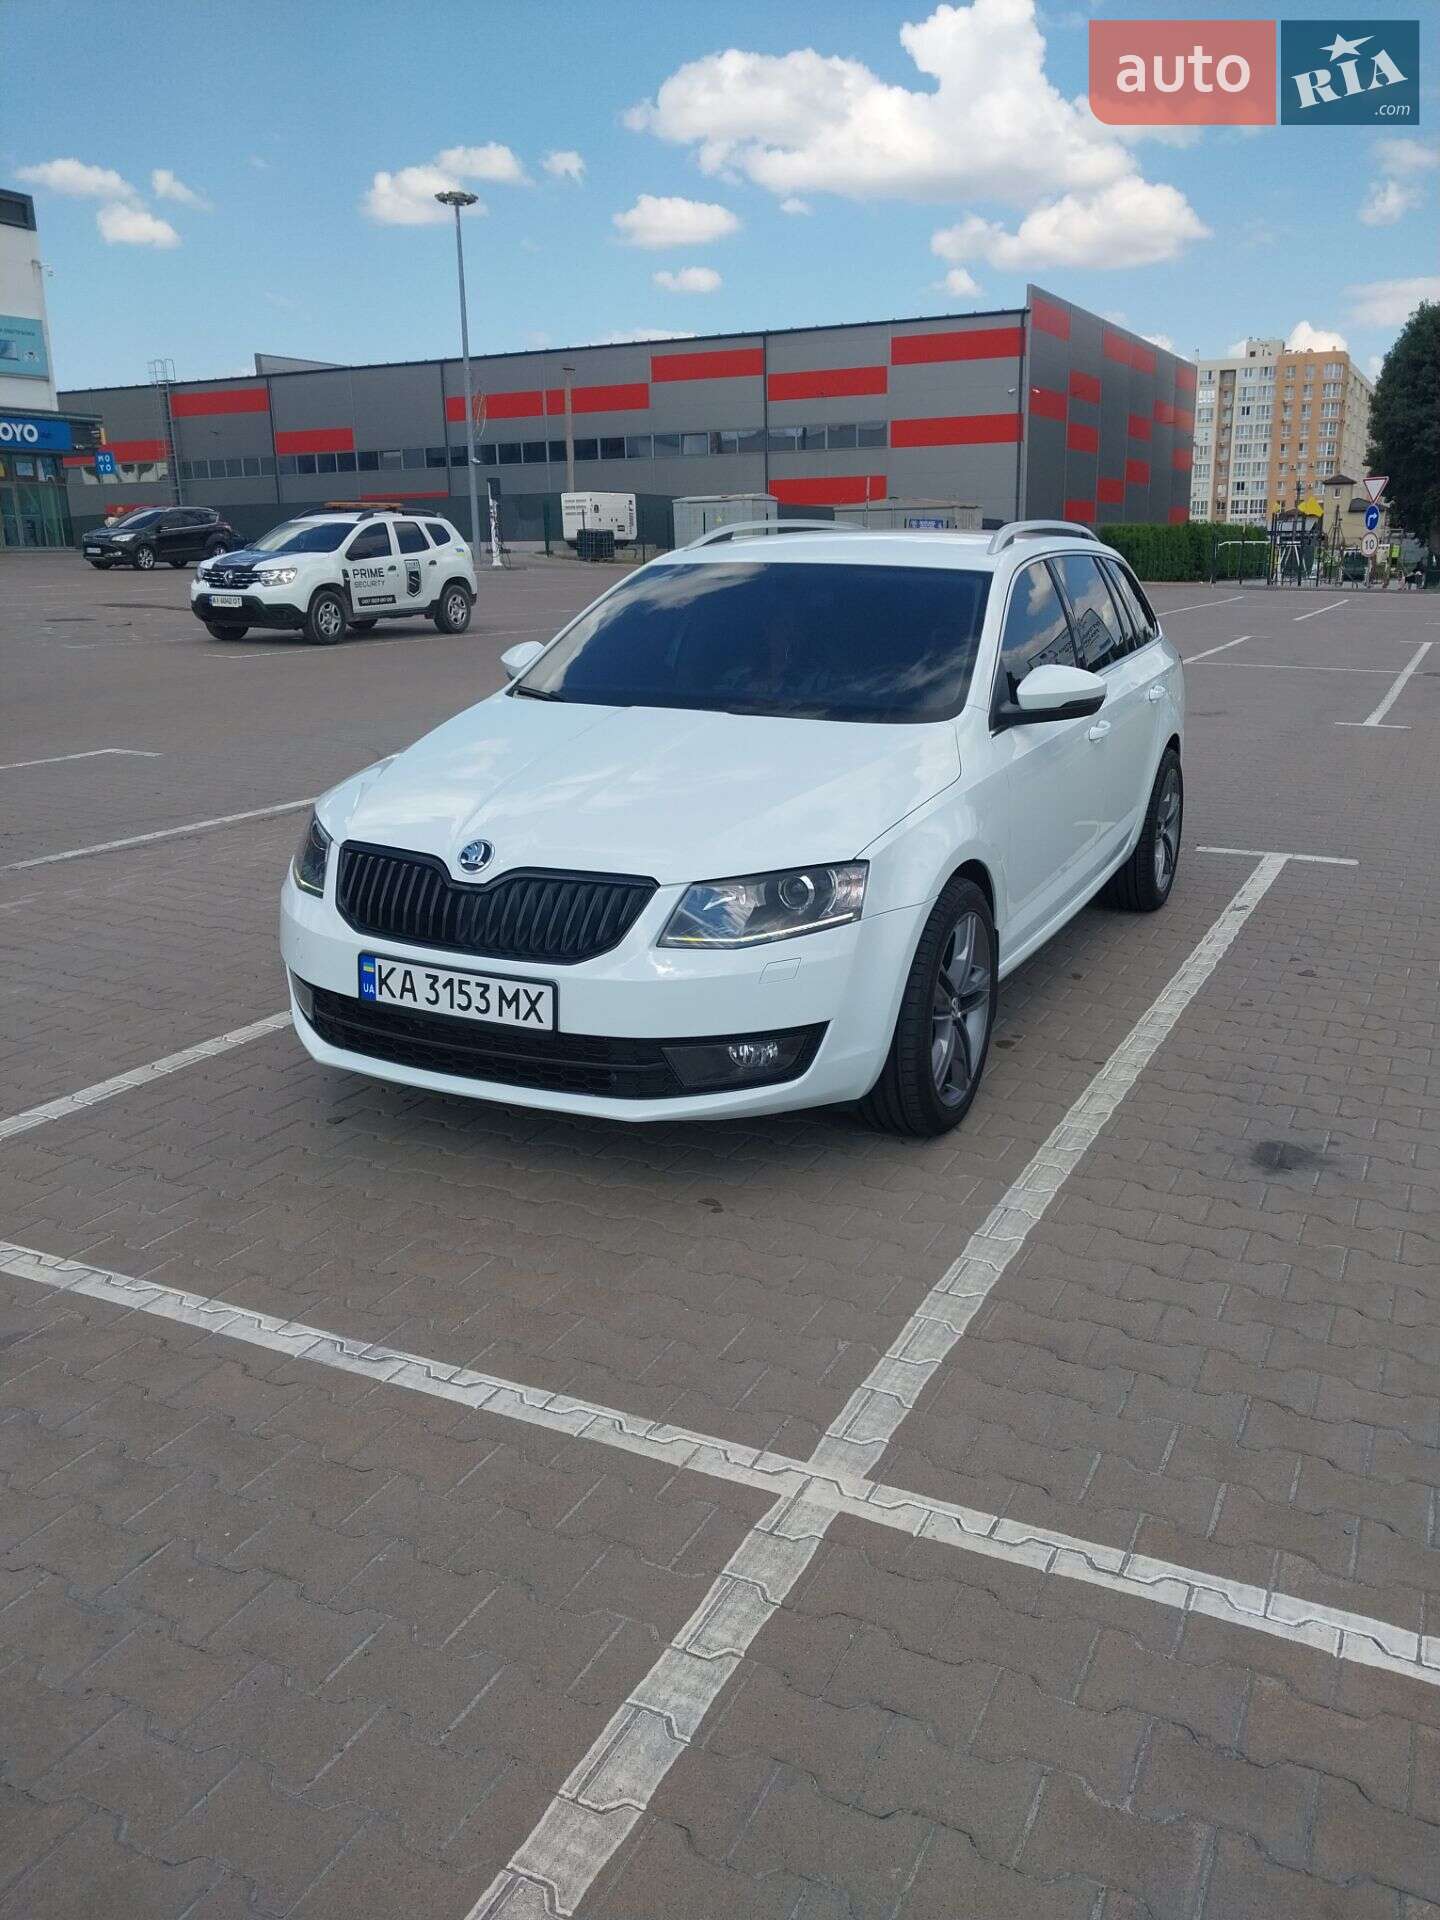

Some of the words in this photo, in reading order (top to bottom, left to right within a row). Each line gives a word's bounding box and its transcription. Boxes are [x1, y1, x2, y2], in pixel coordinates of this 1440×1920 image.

[1365, 539, 1375, 550] 10
[352, 567, 385, 579] PRIME
[354, 580, 386, 589] SECURITY
[363, 983, 375, 994] UA
[377, 964, 418, 1003] KA
[425, 972, 491, 1015] 3153
[498, 985, 545, 1024] MX
